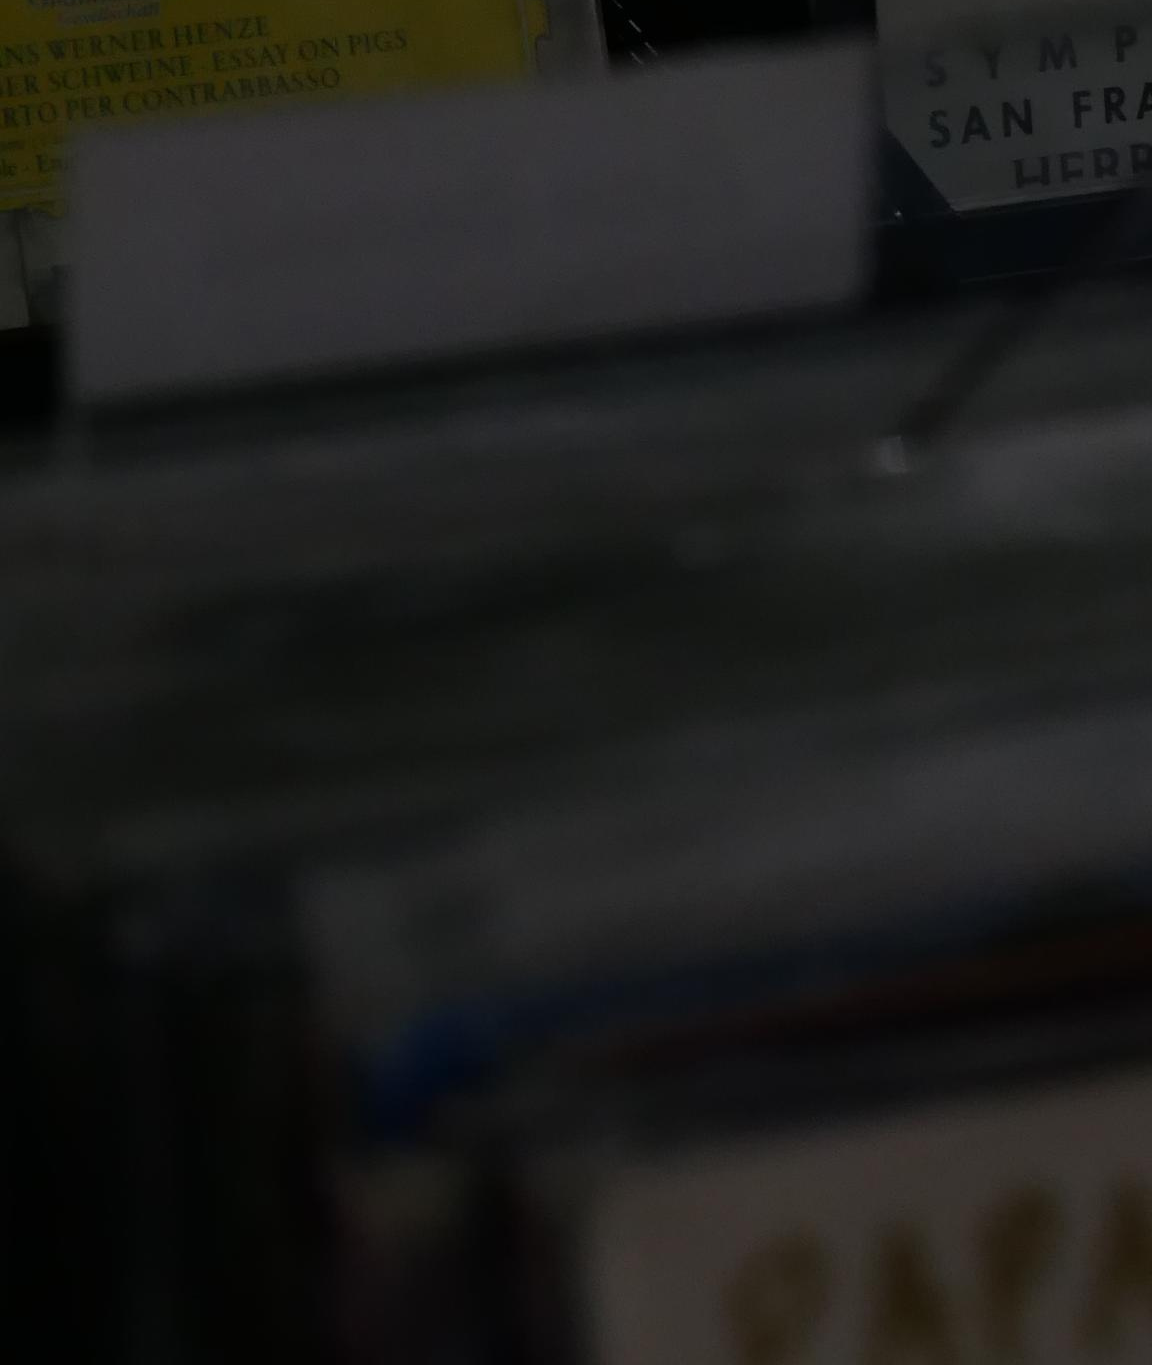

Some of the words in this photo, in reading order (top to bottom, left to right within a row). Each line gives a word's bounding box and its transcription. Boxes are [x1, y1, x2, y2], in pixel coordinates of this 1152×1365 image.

[47, 28, 164, 60] WERNER
[173, 15, 271, 47] HENZE
[47, 55, 191, 93] SCHWEINE
[212, 41, 288, 72] ESSAY
[298, 36, 341, 60] ON
[349, 28, 410, 55] PIGS
[66, 94, 115, 122] PER
[123, 66, 342, 114] CONTRABBASSO
[930, 101, 1033, 149] SAN
